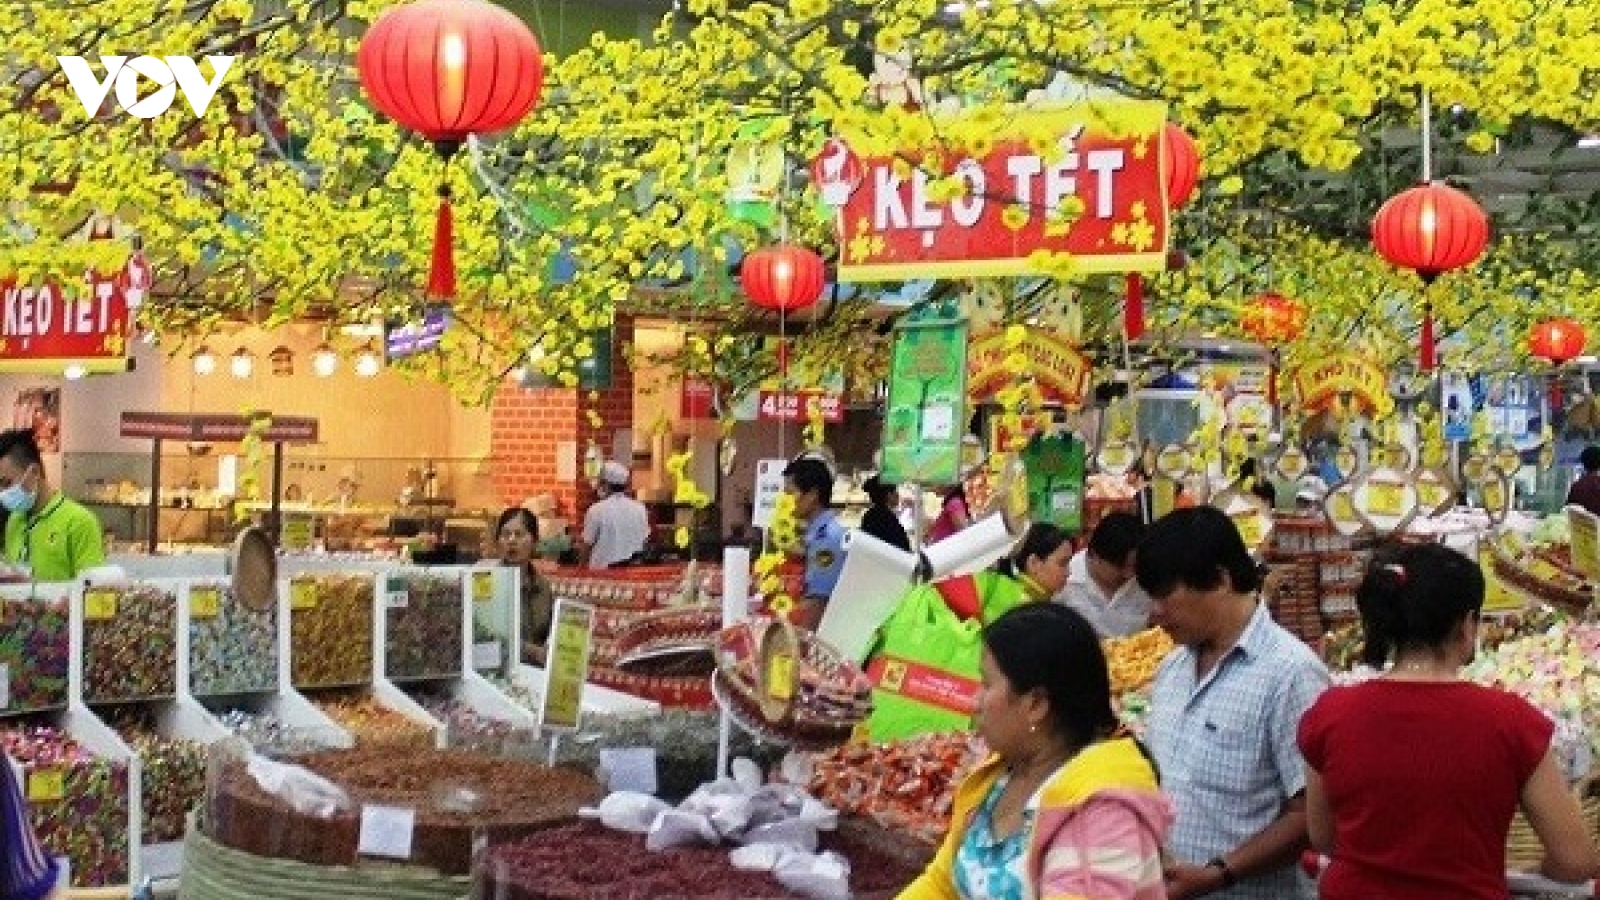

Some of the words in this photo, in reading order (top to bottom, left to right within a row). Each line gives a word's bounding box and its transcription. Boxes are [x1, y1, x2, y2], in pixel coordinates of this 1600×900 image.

[873, 157, 986, 248] KẸO
[1006, 123, 1124, 219] TẾT
[2, 284, 53, 349] KẸO
